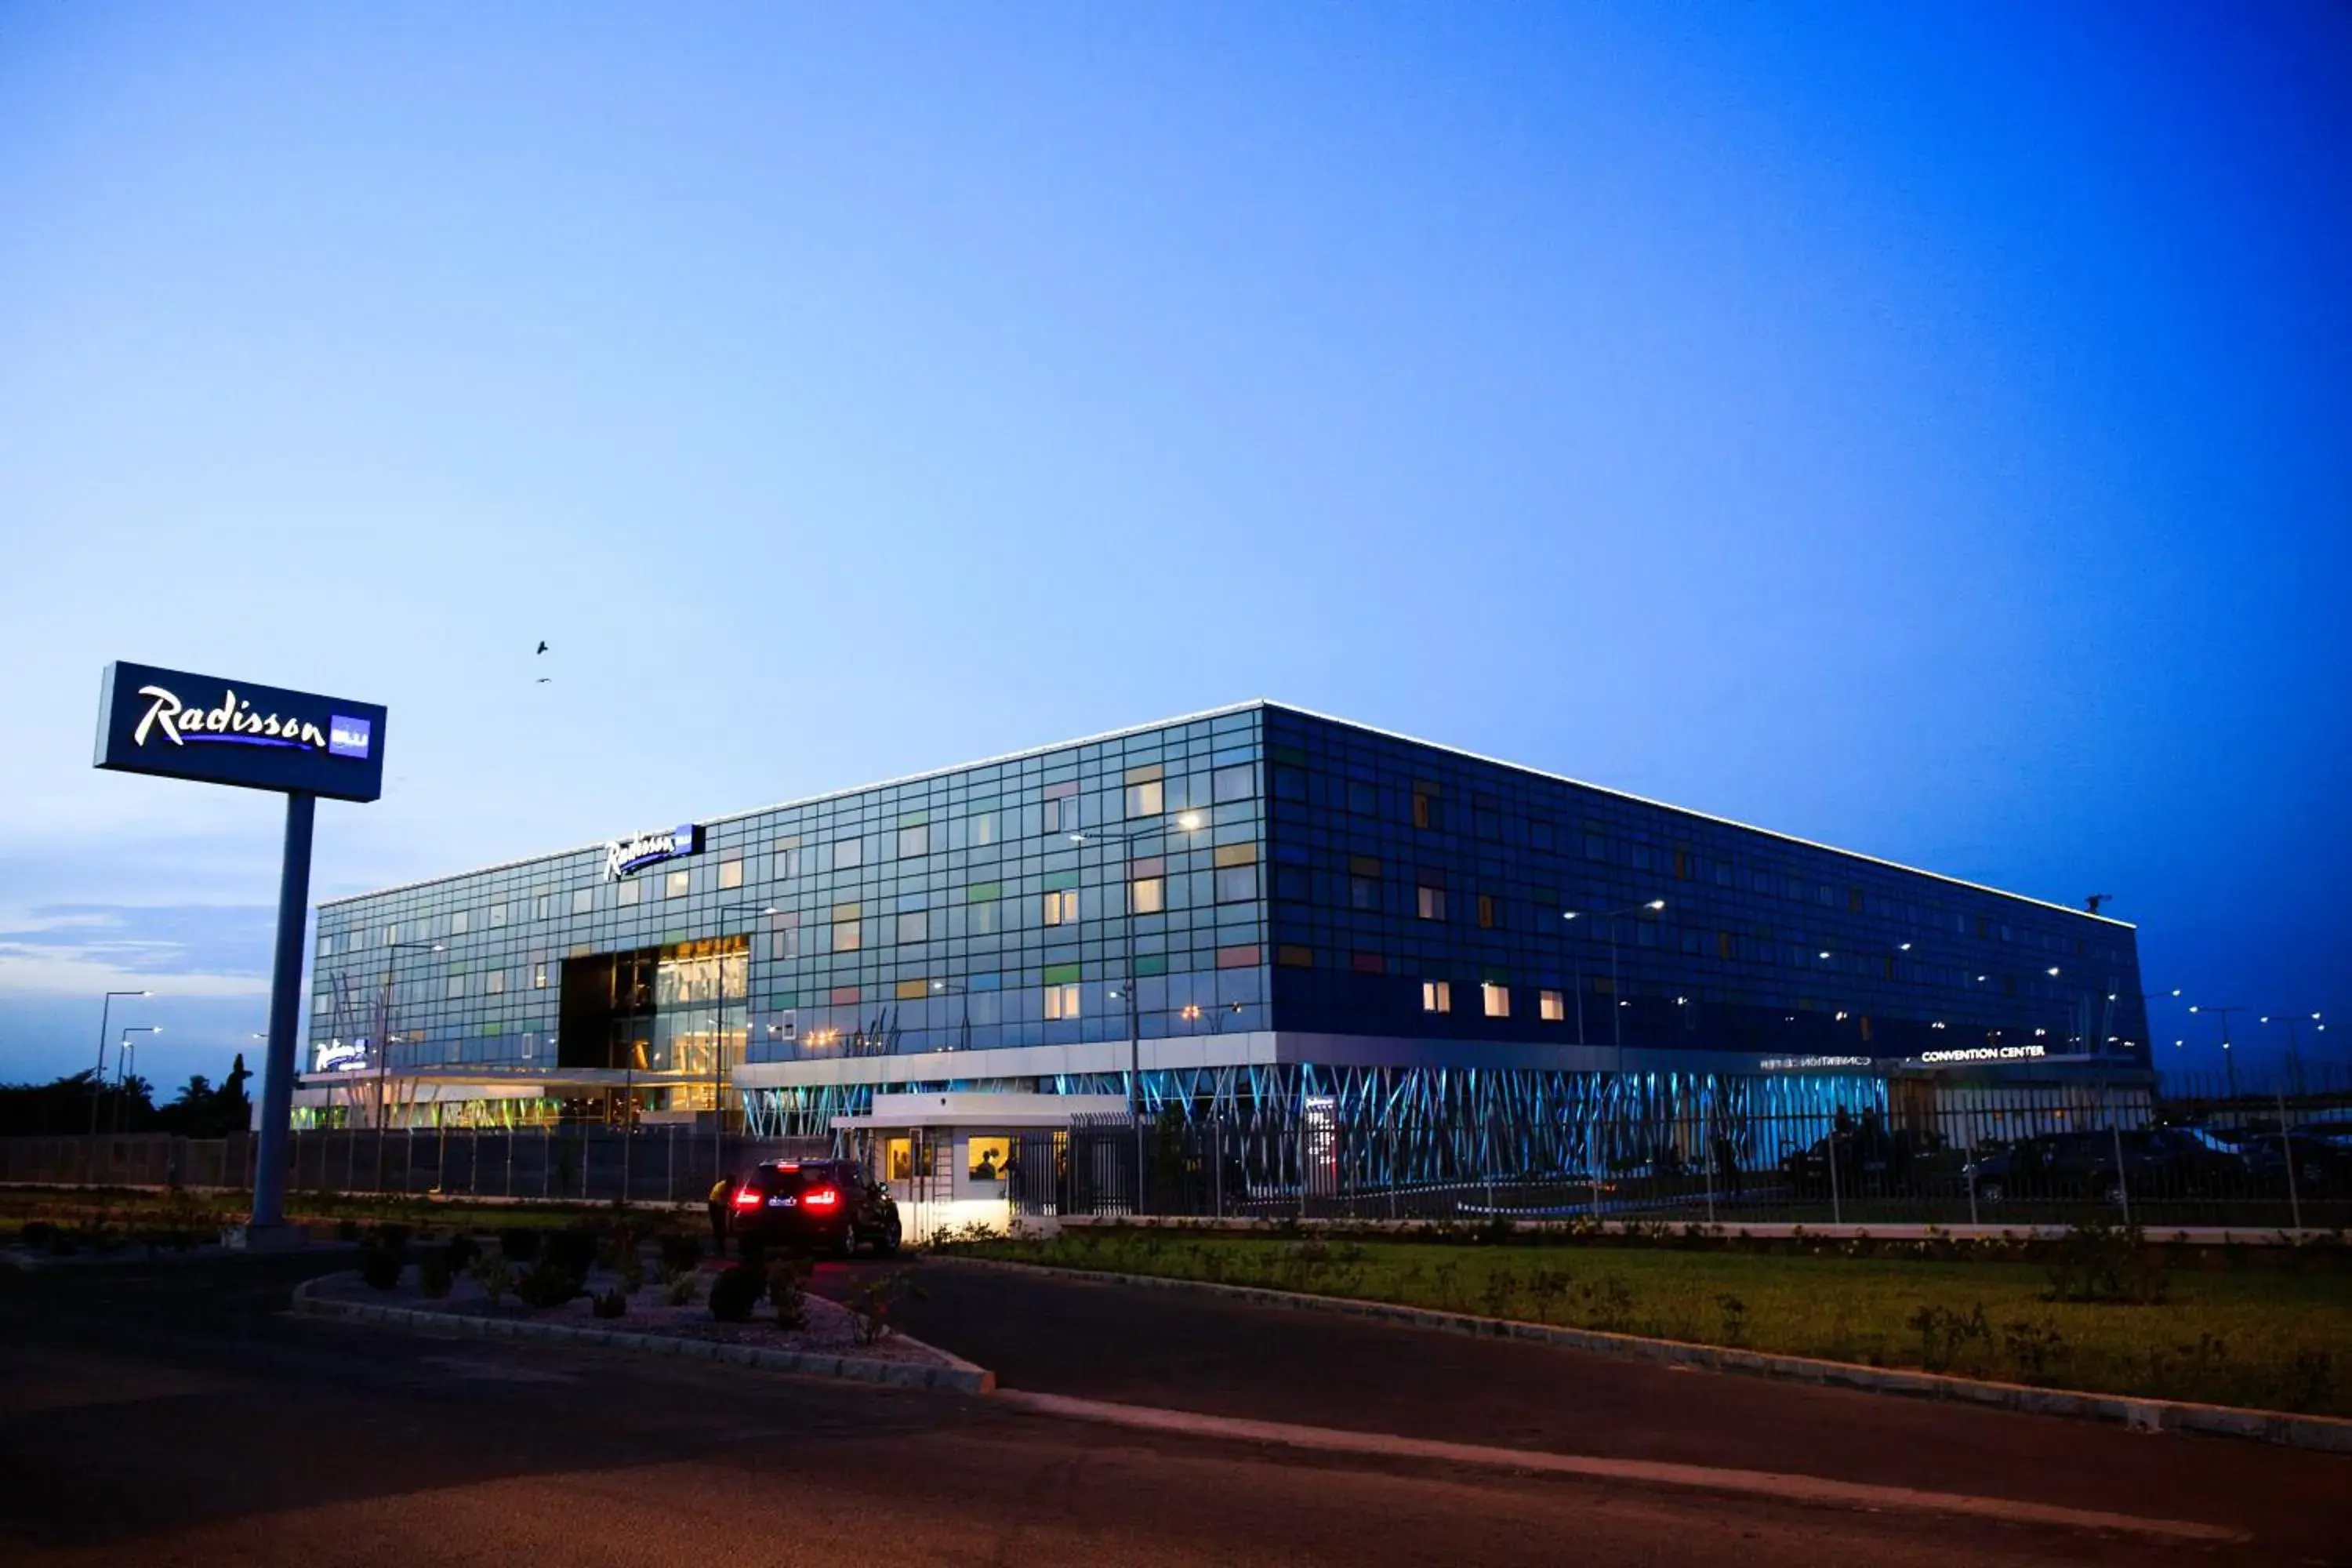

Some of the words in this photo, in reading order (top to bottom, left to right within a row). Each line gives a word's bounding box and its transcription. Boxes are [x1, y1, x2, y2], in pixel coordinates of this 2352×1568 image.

[134, 684, 326, 747] Radisson
[1922, 1048, 1998, 1062] CONVENTION
[2000, 1045, 2045, 1058] CENTER
